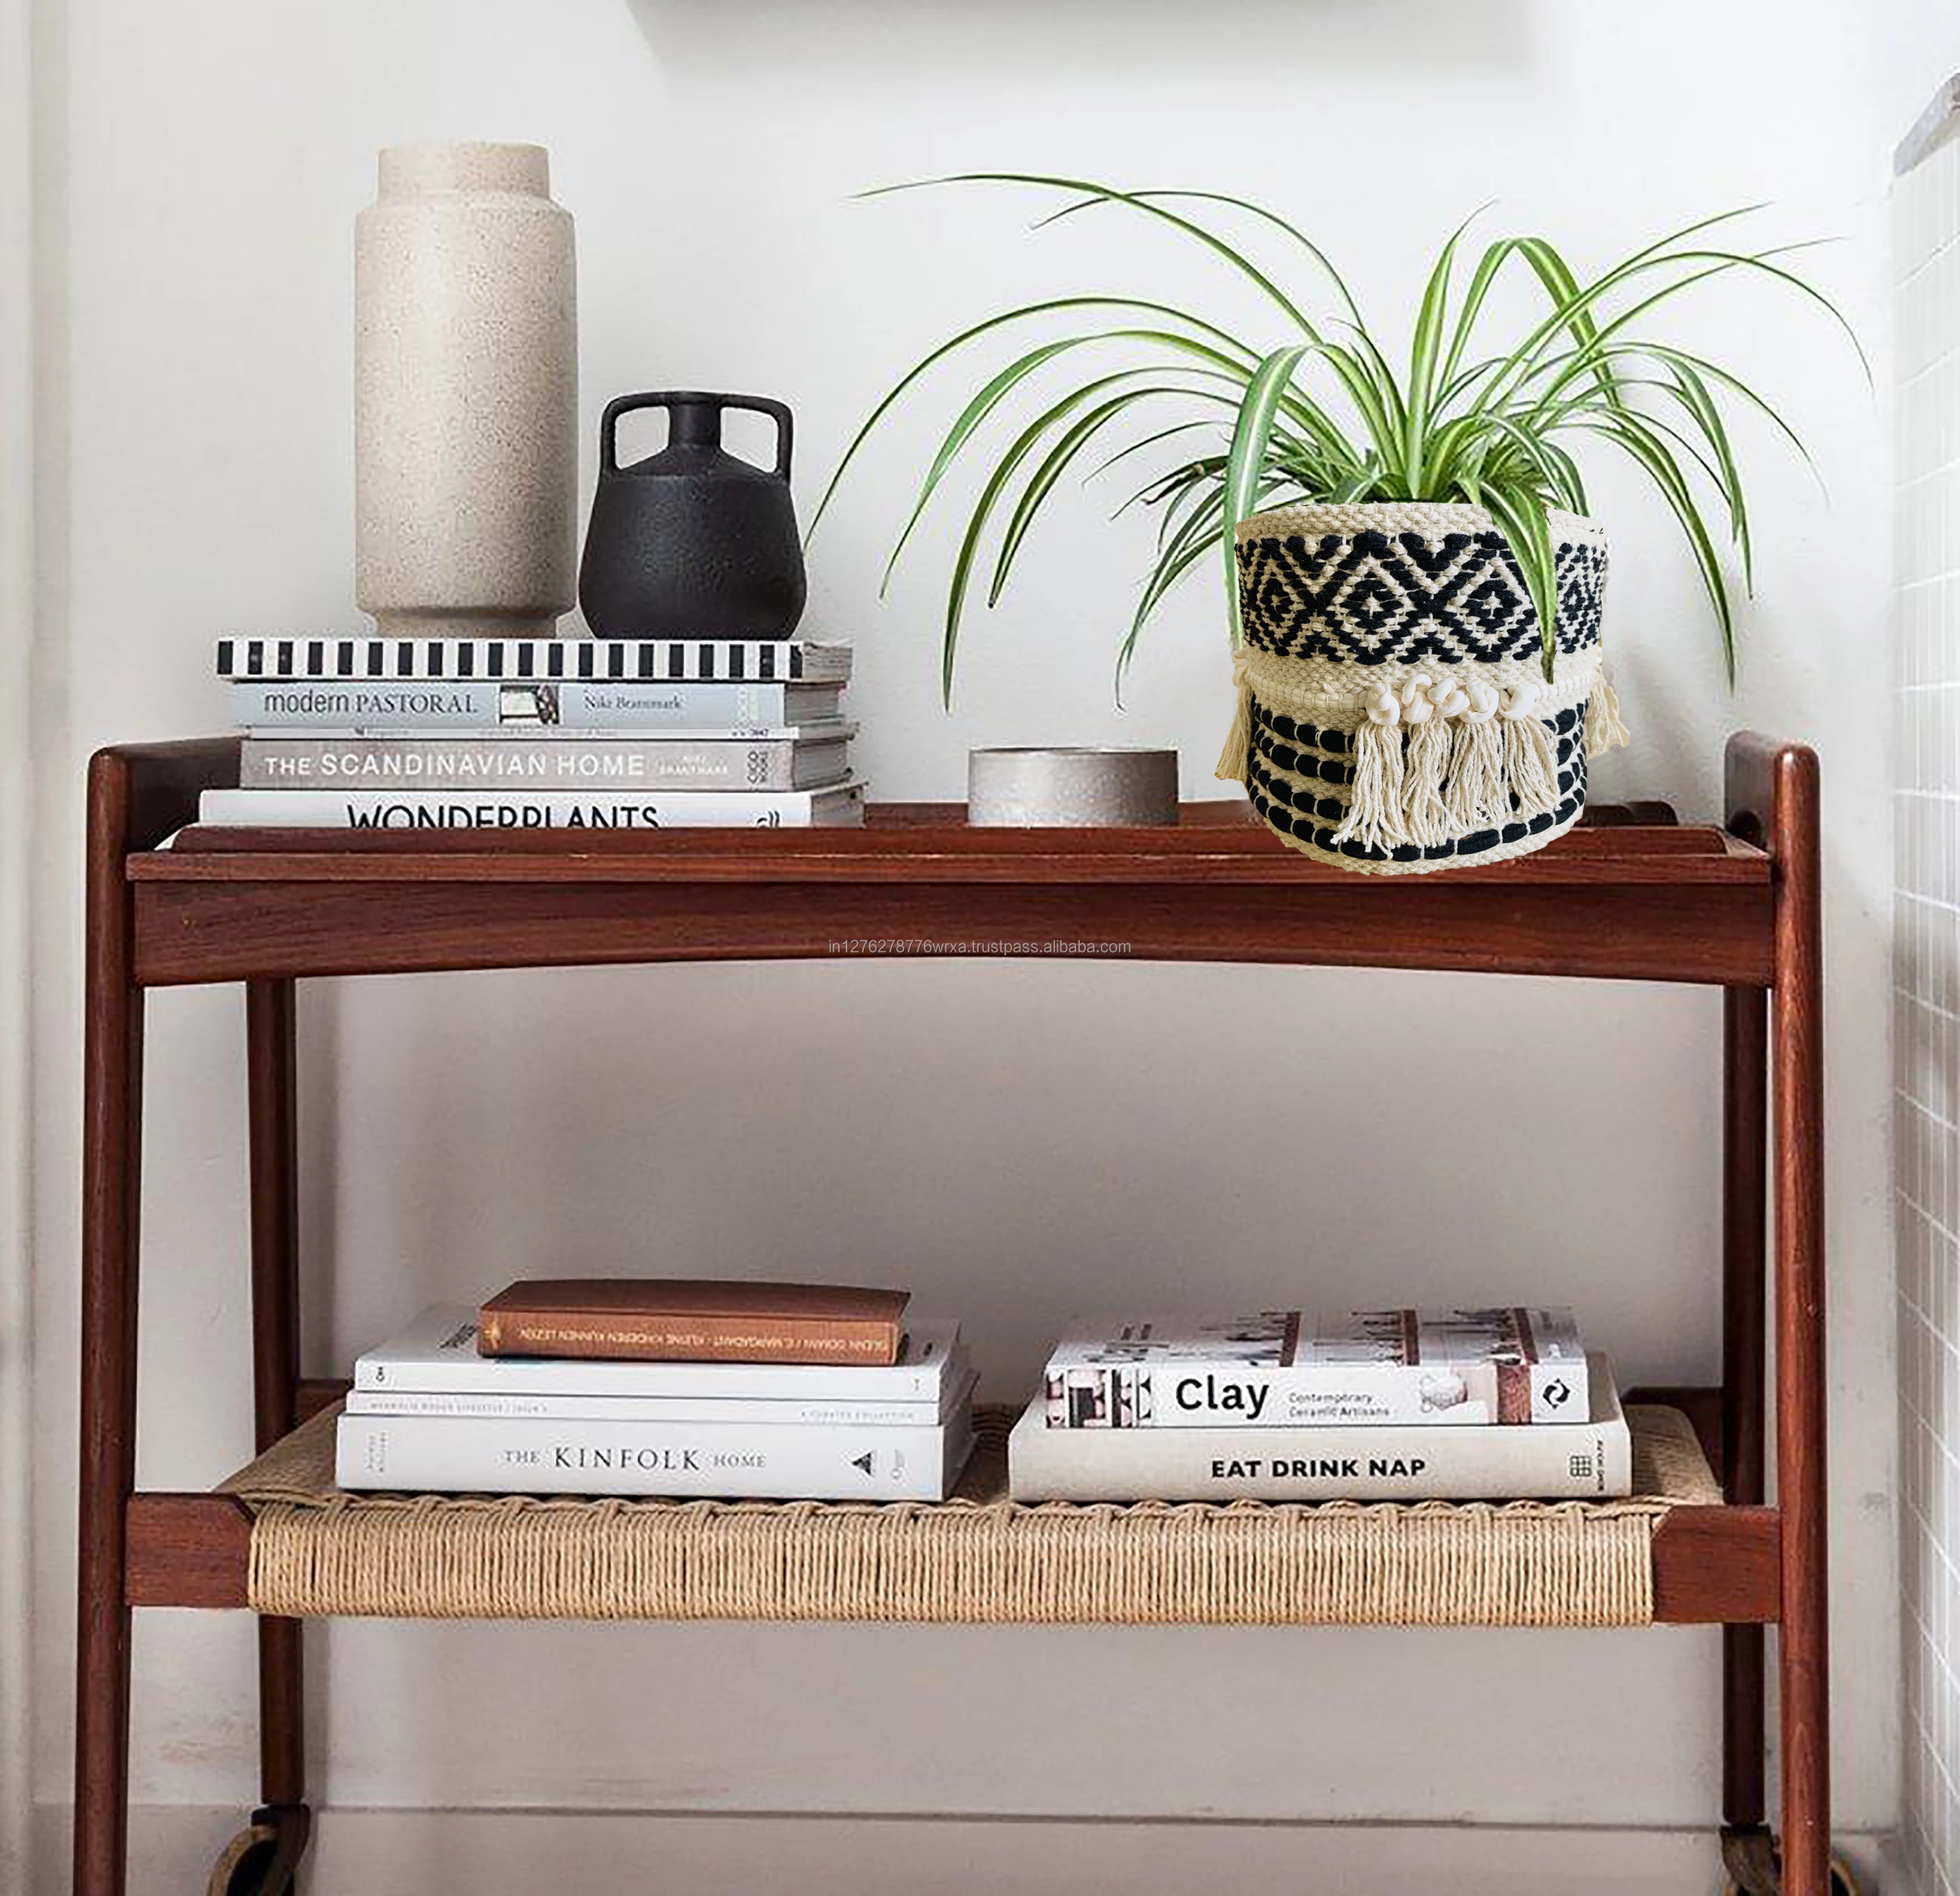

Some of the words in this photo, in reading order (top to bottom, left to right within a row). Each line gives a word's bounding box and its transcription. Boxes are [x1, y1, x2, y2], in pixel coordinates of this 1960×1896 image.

[265, 689, 349, 713] modern
[356, 694, 478, 713] PASTORAL
[265, 757, 311, 776] THE
[321, 753, 546, 776] SCANDINAVIAN
[557, 754, 644, 776] HOME
[1175, 1374, 1269, 1420] Clay
[505, 1450, 540, 1463] THE
[555, 1447, 700, 1471] KINFOLK
[713, 1454, 766, 1467] HOME
[1212, 1460, 1262, 1478] EAT
[1272, 1460, 1359, 1477] DRINK
[1369, 1459, 1426, 1477] NAP
